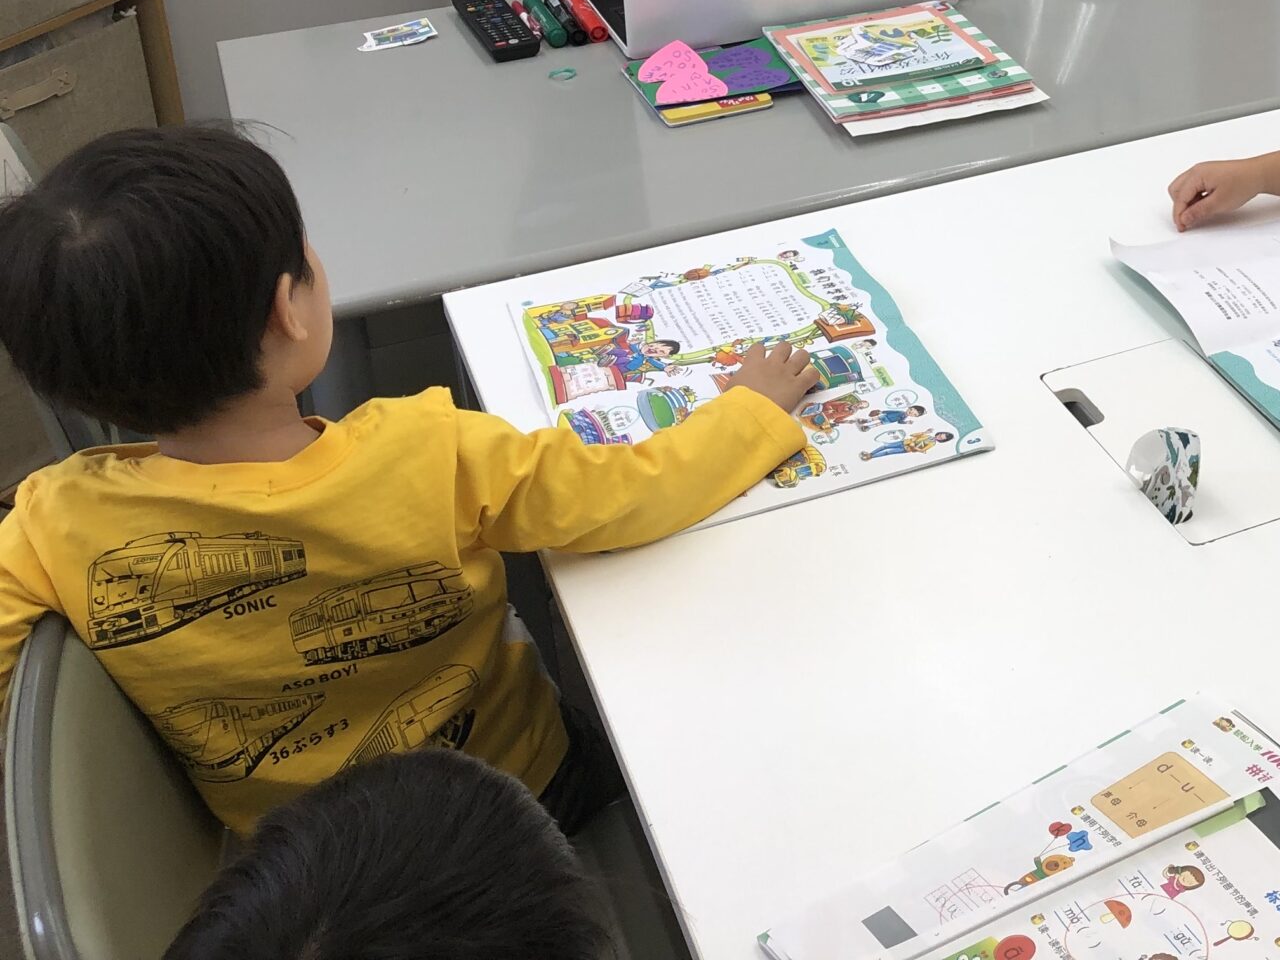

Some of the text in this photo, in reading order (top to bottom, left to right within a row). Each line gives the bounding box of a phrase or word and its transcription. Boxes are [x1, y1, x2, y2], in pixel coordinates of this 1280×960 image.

[223, 595, 277, 620] SONIC
[281, 664, 358, 693] ASO BOY!
[1101, 790, 1122, 807] 声母
[1193, 850, 1260, 920] 请写出下列音节的声调。
